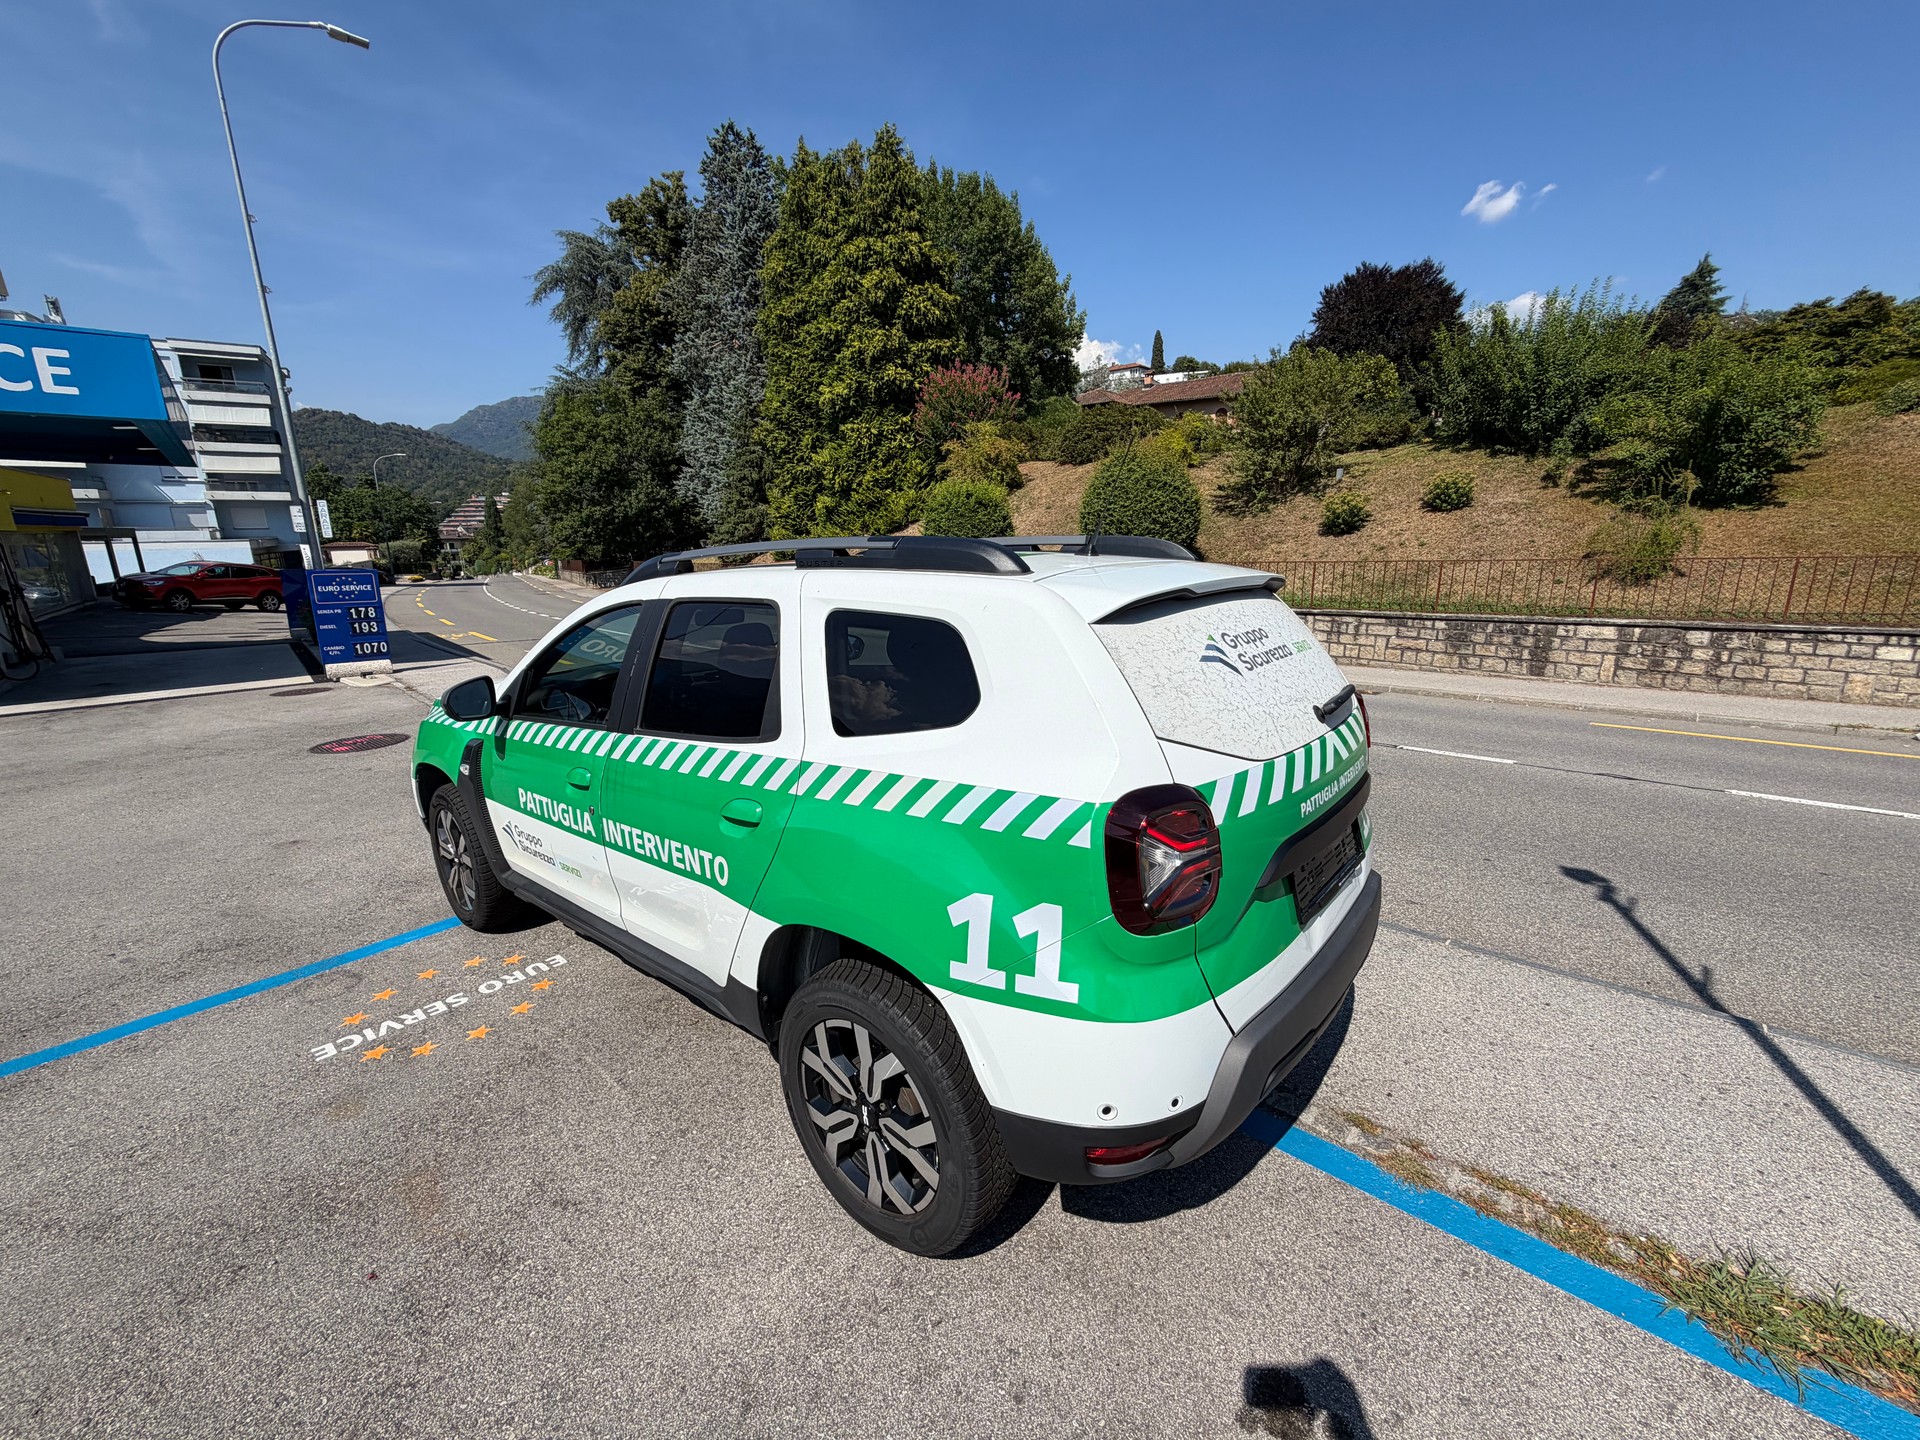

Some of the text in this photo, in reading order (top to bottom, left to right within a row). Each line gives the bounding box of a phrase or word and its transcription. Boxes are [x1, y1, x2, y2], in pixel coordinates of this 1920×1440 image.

[318, 501, 331, 537] GARAGE
[1220, 627, 1270, 650] Gruppo
[1237, 644, 1294, 672] Sicurezza
[1300, 779, 1339, 818] PATTUGLIA
[513, 824, 543, 849] Gruppo
[518, 787, 729, 887] PATTUGLIA INTERVENTO
[518, 839, 557, 867] Sicurezza
[946, 892, 1080, 1004] 11
[310, 954, 568, 1062] EURO SERVICE
